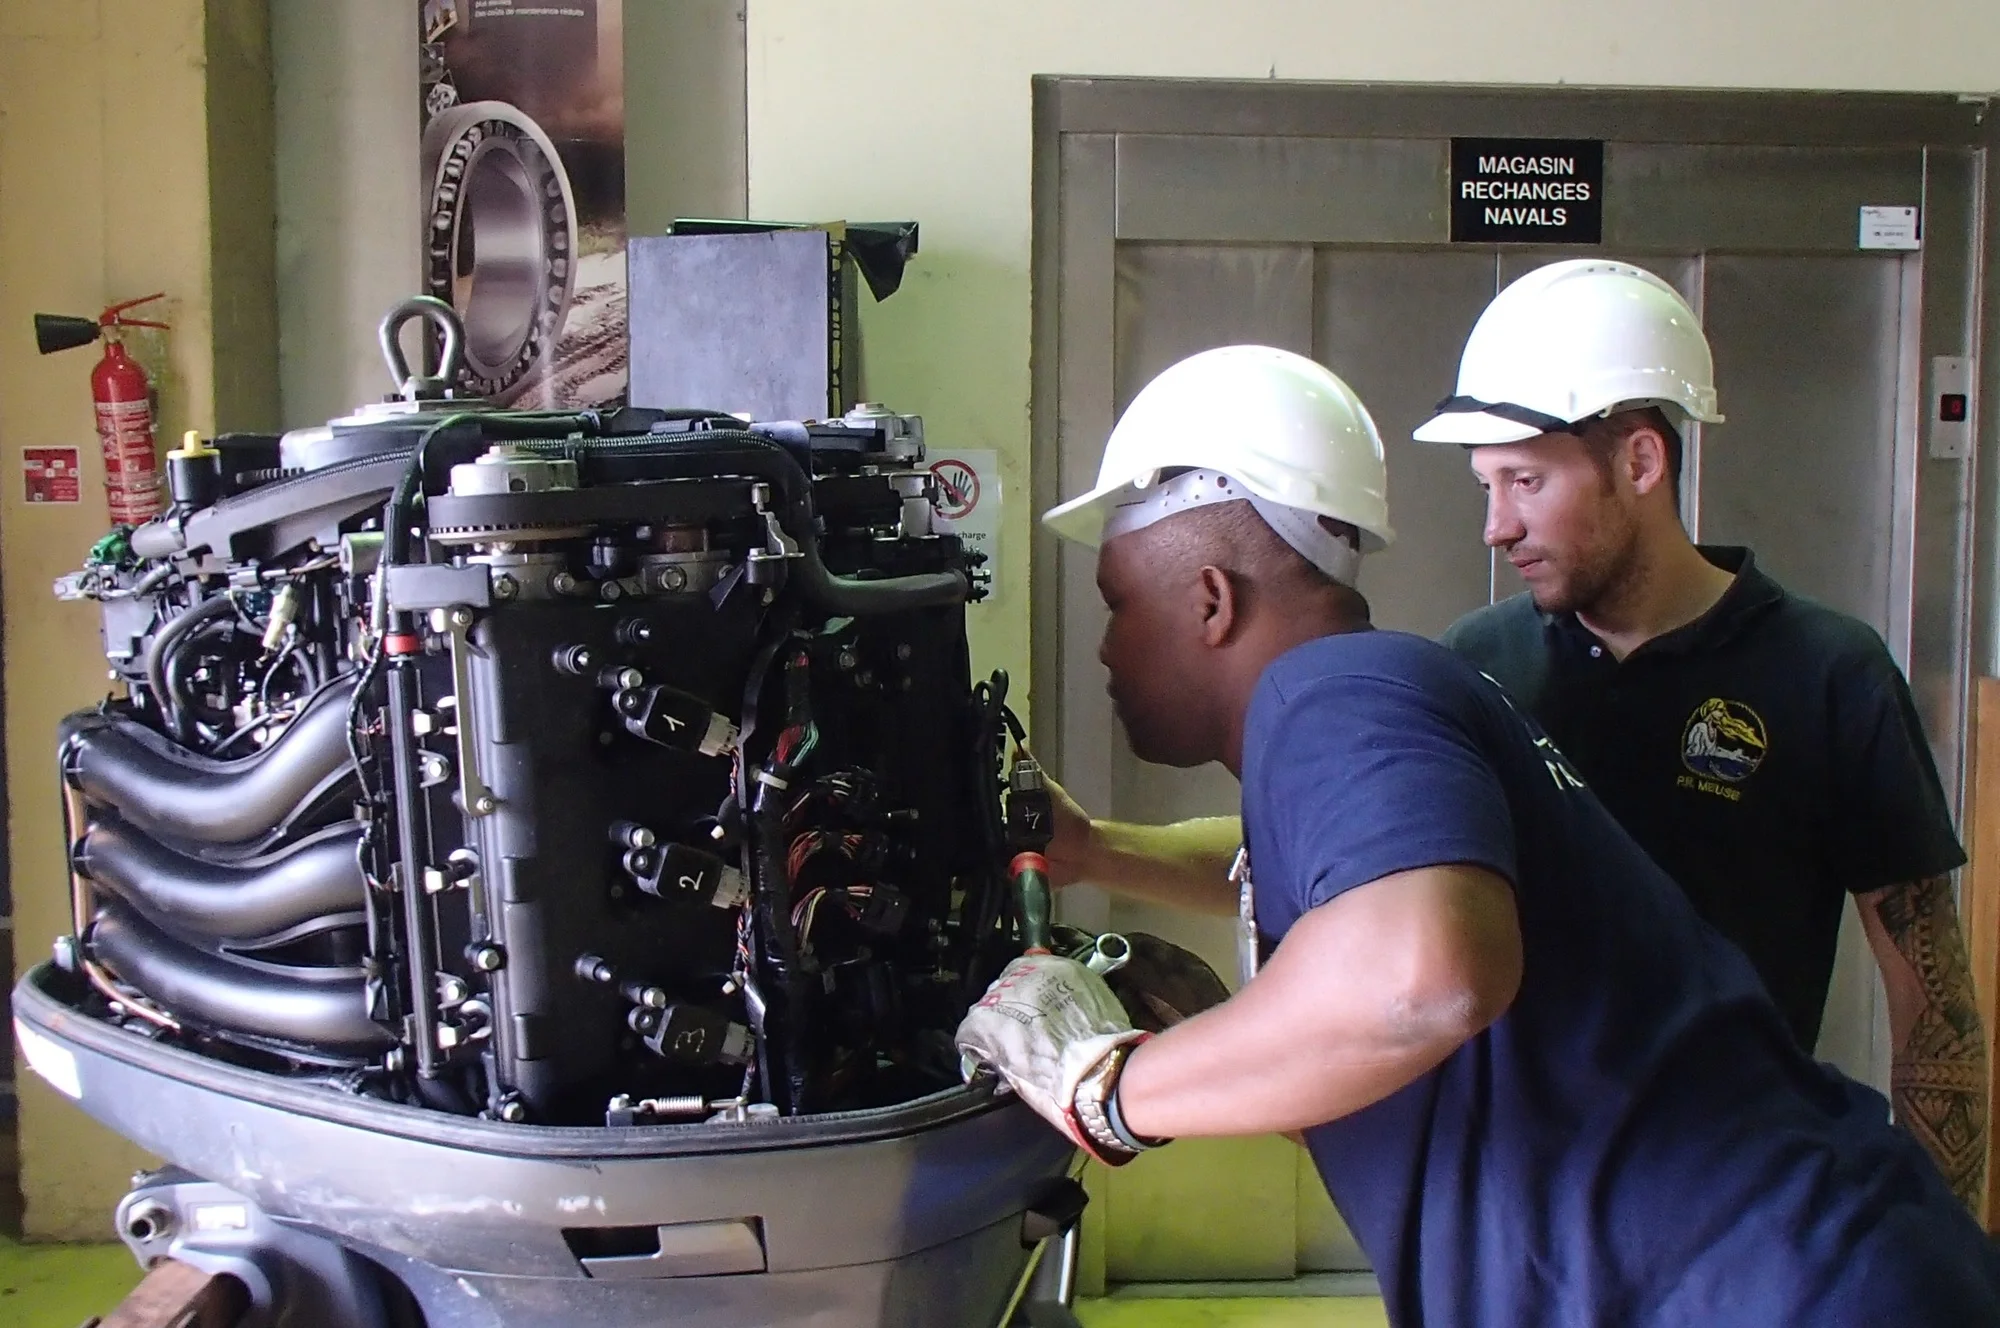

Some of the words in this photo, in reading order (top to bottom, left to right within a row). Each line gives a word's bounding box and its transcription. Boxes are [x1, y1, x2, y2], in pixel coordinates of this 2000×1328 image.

[1478, 156, 1574, 175] MAGASIN
[1461, 181, 1590, 201] RECHANGES
[1484, 207, 1567, 226] NAVALS
[662, 714, 685, 732] 1
[1697, 779, 1741, 801] MEUSE
[1024, 806, 1041, 829] 4
[679, 871, 704, 890] 2
[675, 1028, 705, 1052] 3
